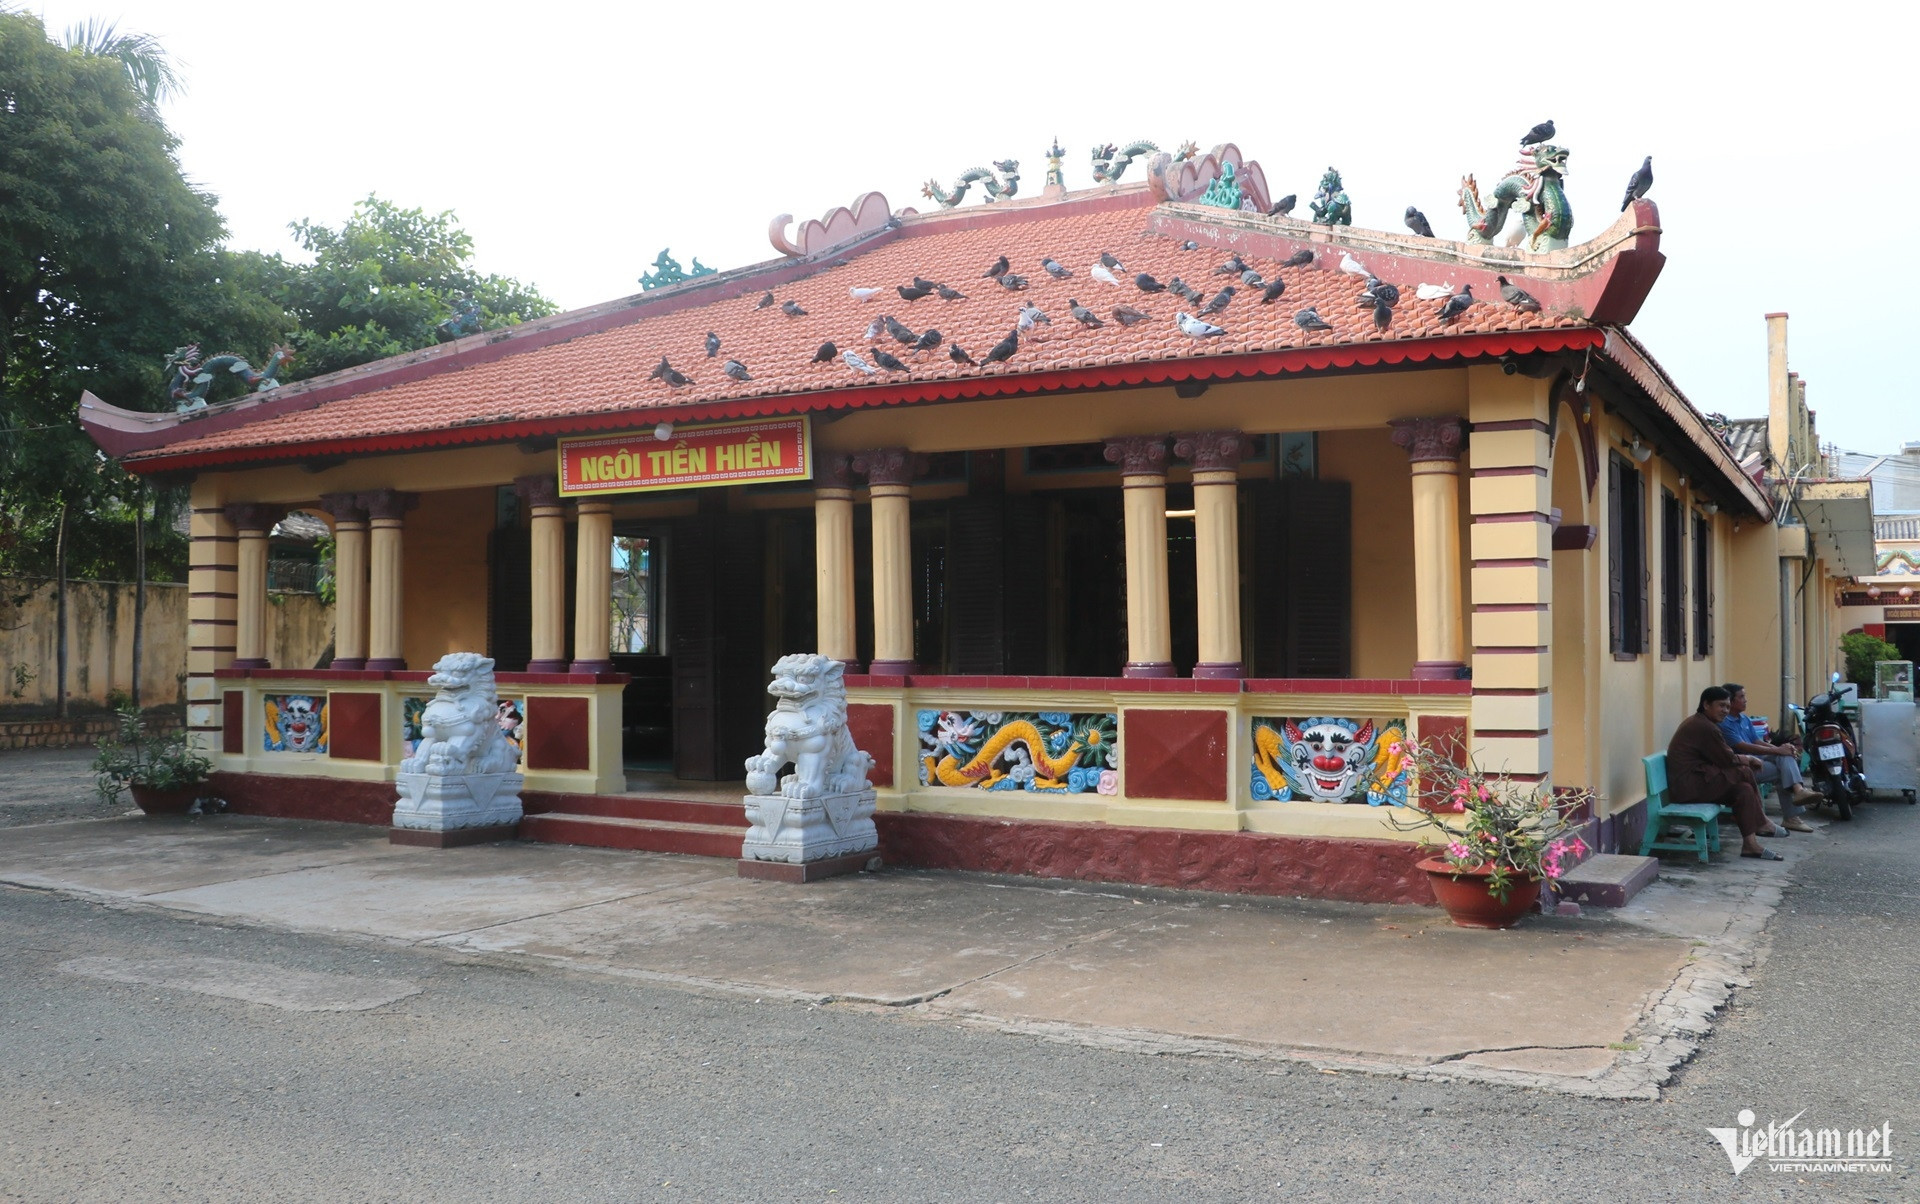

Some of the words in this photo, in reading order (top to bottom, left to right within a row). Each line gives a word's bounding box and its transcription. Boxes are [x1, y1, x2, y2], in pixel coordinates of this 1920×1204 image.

[580, 447, 641, 482] NGÔI
[648, 440, 707, 477] TIỀN
[716, 433, 781, 472] HIỀN
